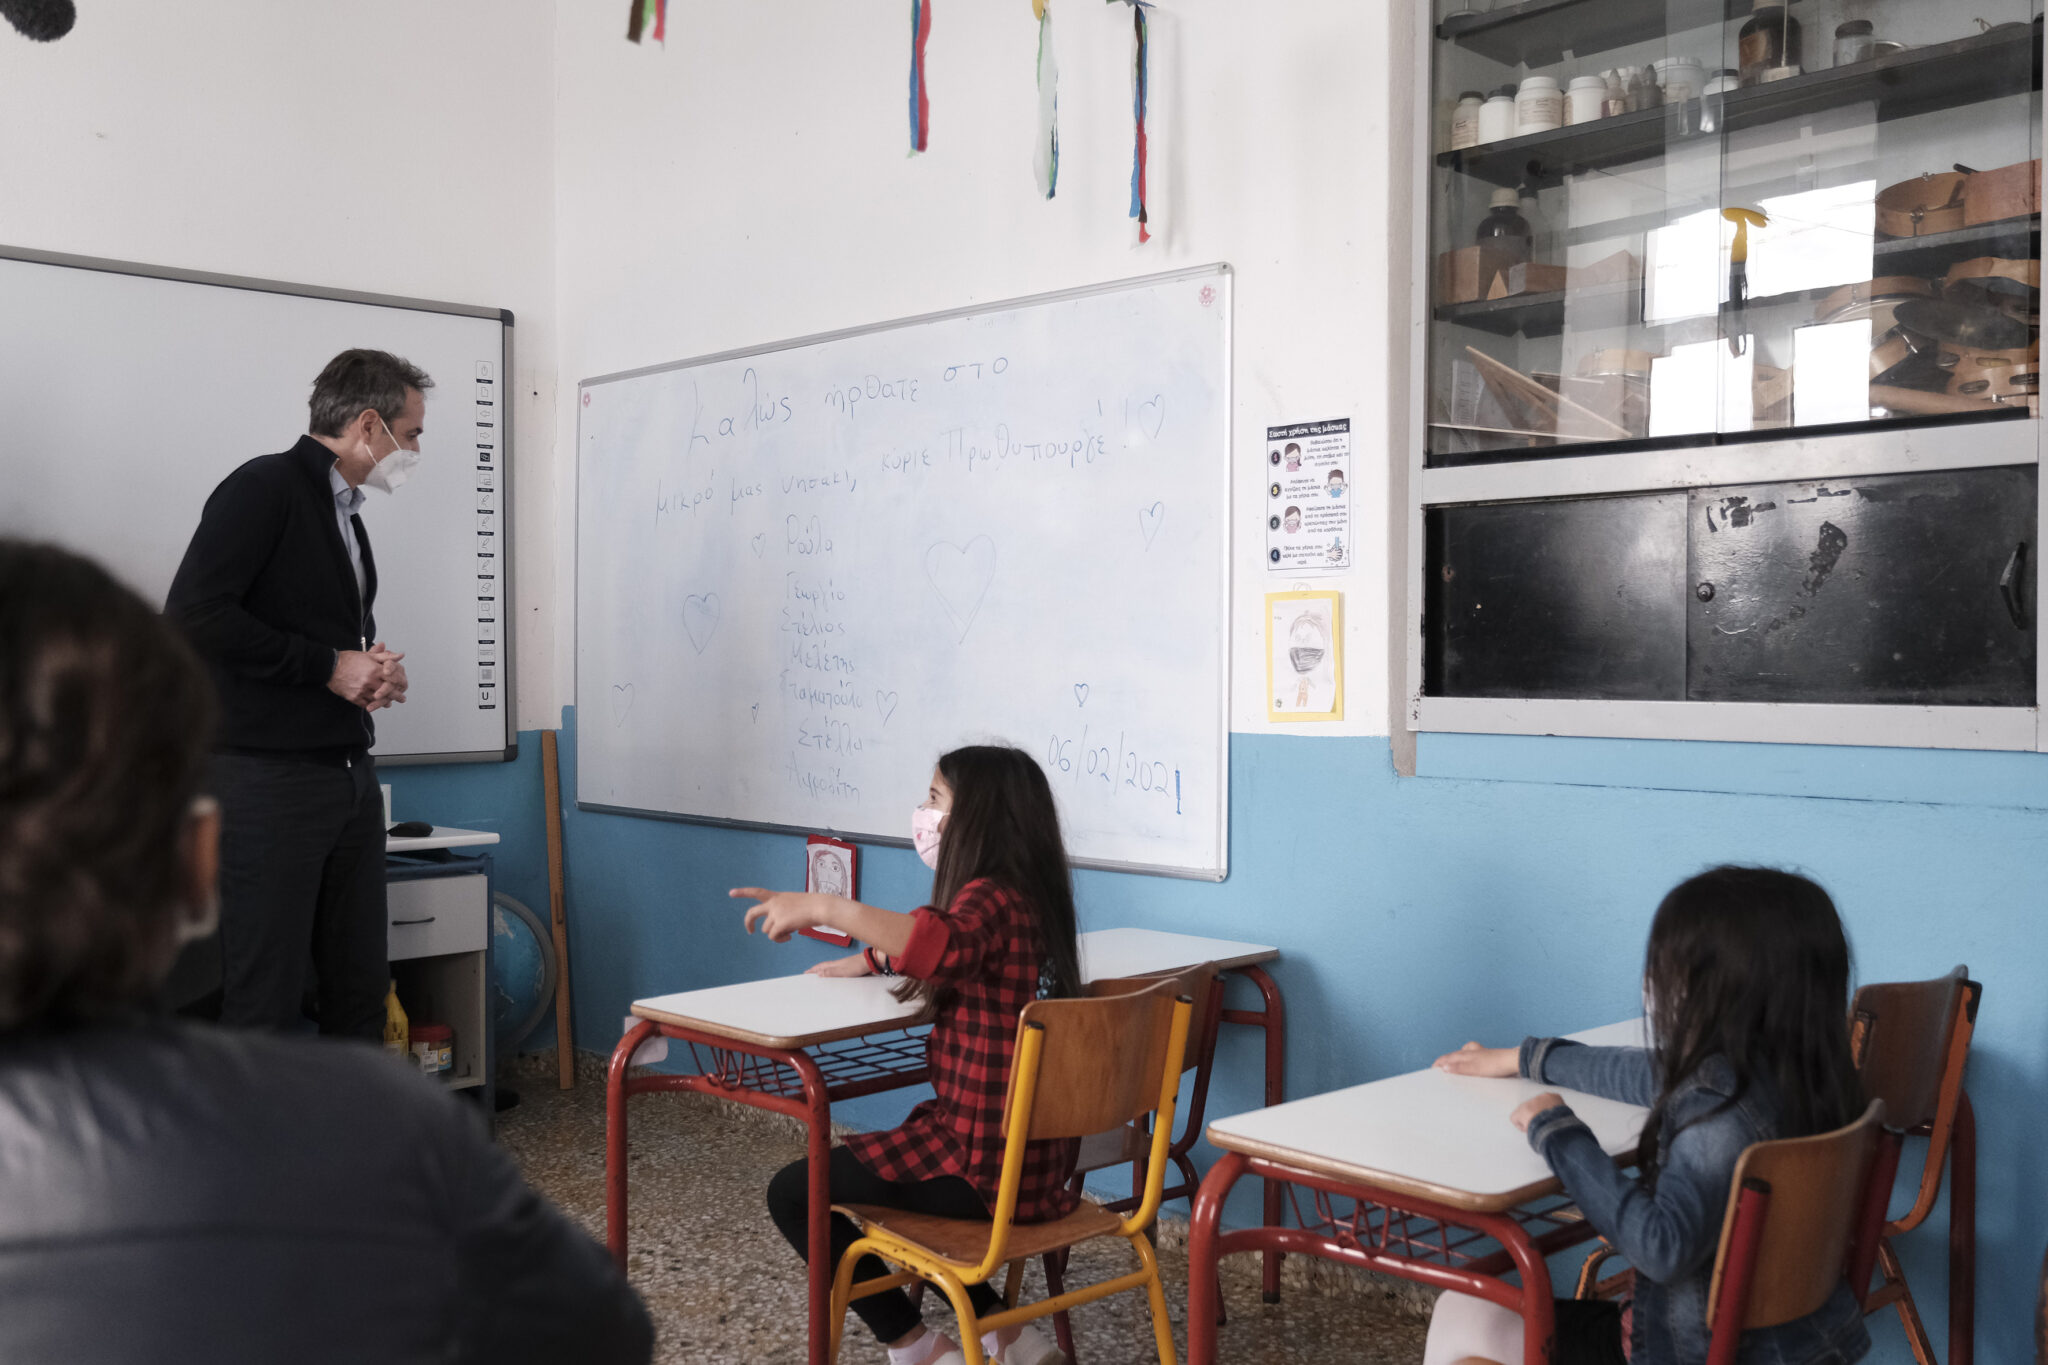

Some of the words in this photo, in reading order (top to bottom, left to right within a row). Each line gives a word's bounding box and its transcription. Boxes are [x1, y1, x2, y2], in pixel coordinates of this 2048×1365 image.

[943, 356, 1009, 382] στο
[730, 477, 763, 516] μας
[797, 715, 864, 757] Στέλλα
[1048, 723, 1183, 816] 06/02/2021
